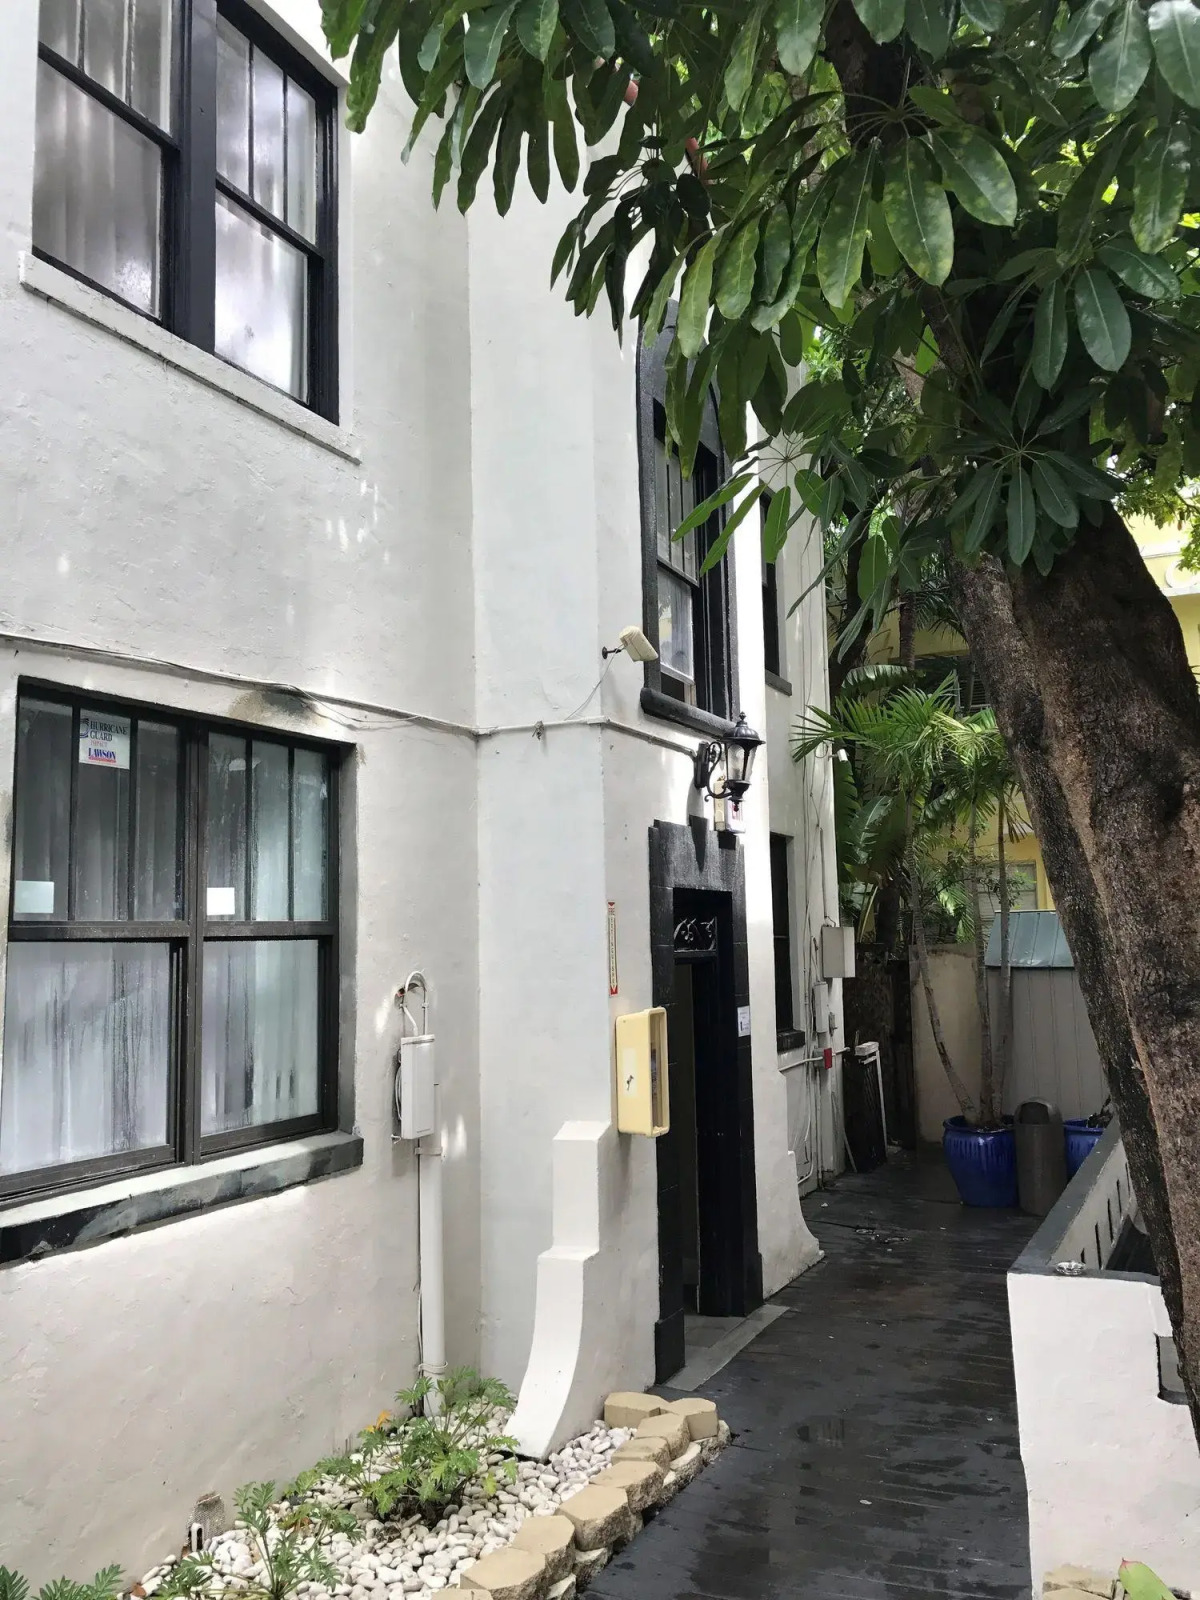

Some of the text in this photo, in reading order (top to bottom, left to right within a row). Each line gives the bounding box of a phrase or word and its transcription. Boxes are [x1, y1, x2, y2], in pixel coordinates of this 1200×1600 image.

[90, 720, 128, 735] HURRICANE
[90, 730, 113, 742] GUARD
[88, 747, 116, 760] LAWSON
